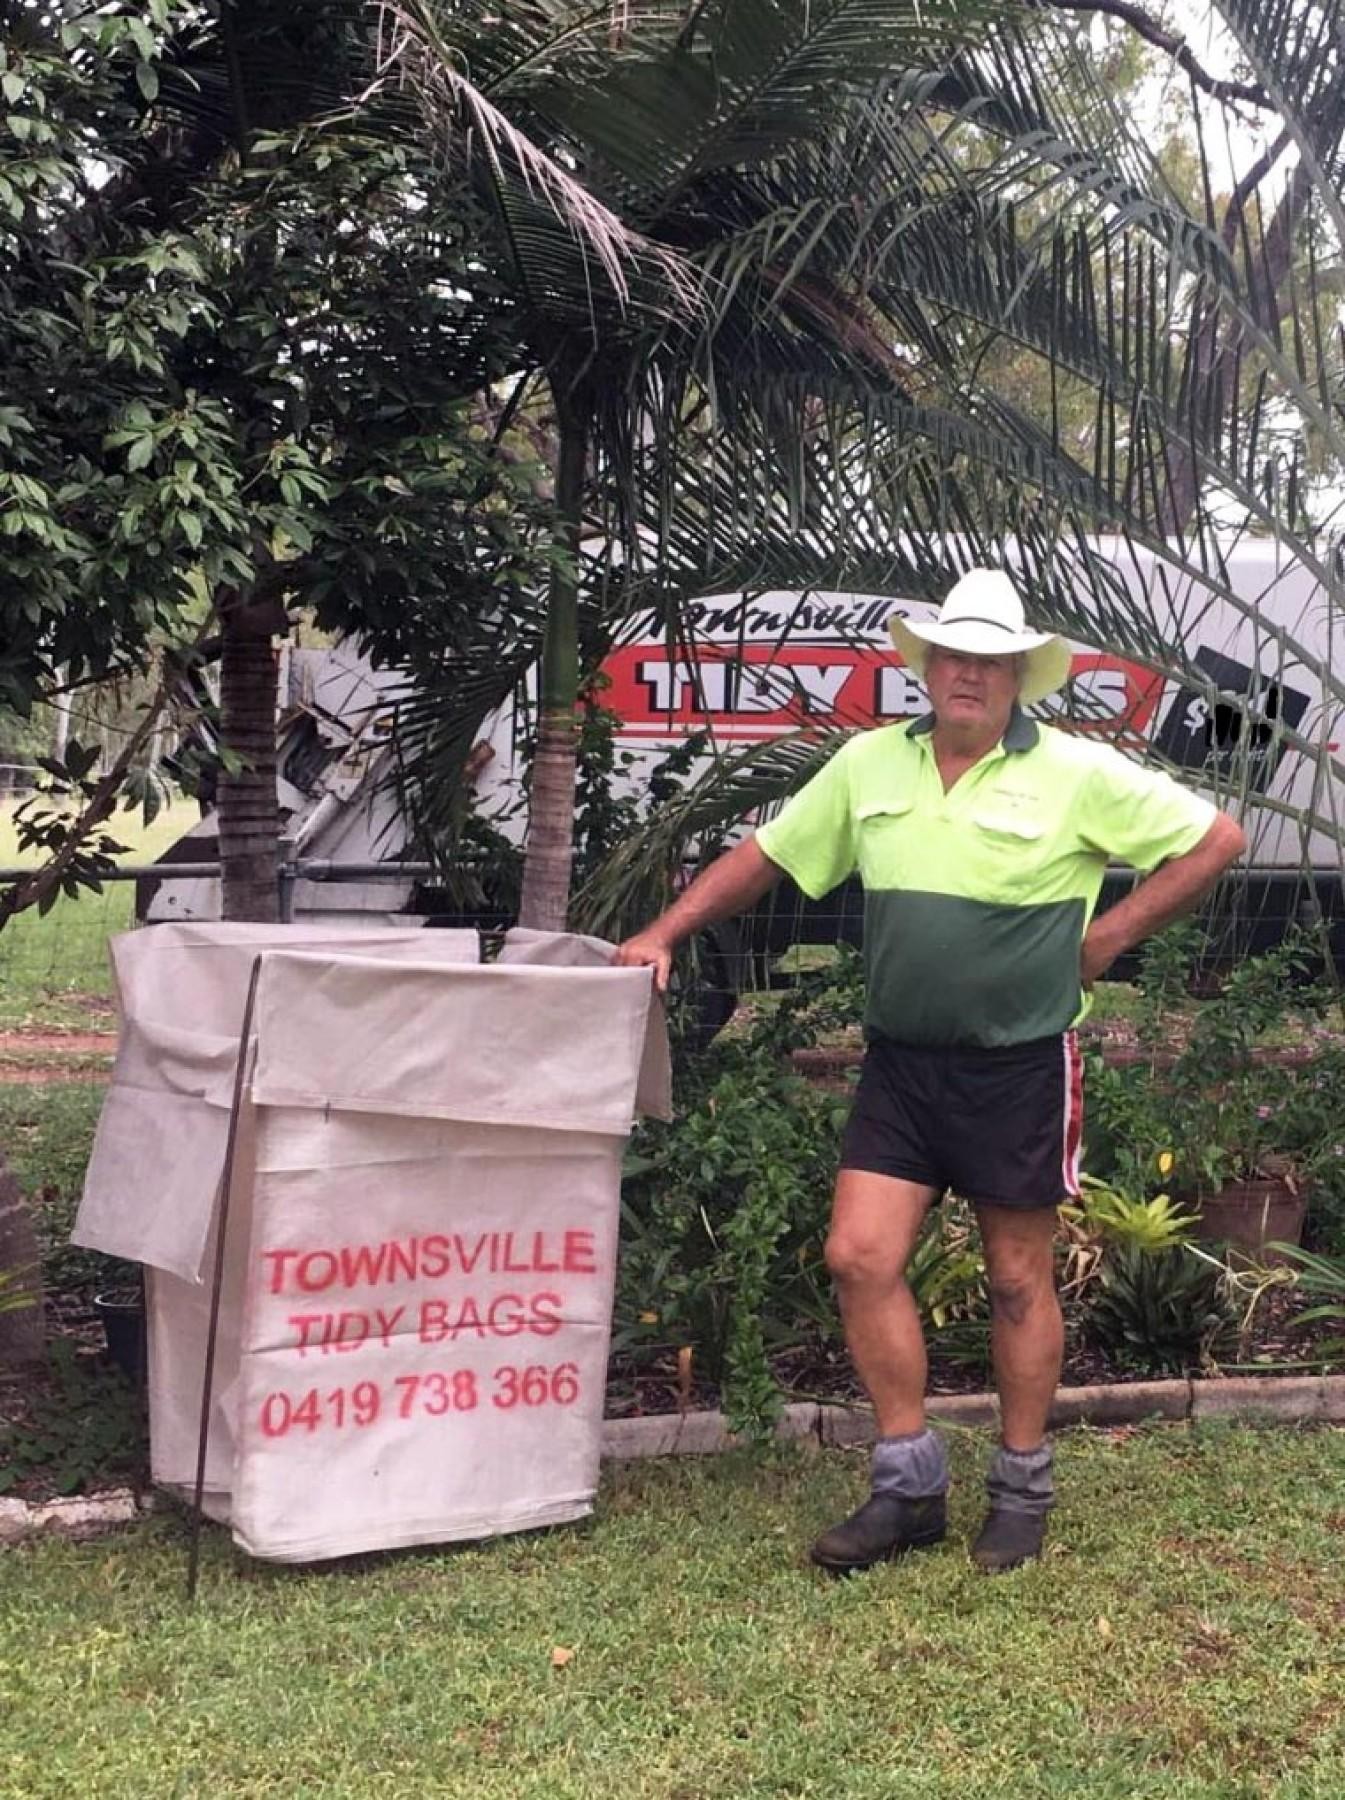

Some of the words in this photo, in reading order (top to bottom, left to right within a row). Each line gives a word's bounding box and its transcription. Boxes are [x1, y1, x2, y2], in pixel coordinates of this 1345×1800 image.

[636, 660, 855, 714] TIDY
[263, 1230, 597, 1295] TOWNSVILLE
[288, 1306, 405, 1357] TIDY
[419, 1292, 563, 1344] BAGS
[260, 1381, 380, 1437] 0419
[395, 1369, 477, 1419] 738
[492, 1362, 580, 1410] 366
